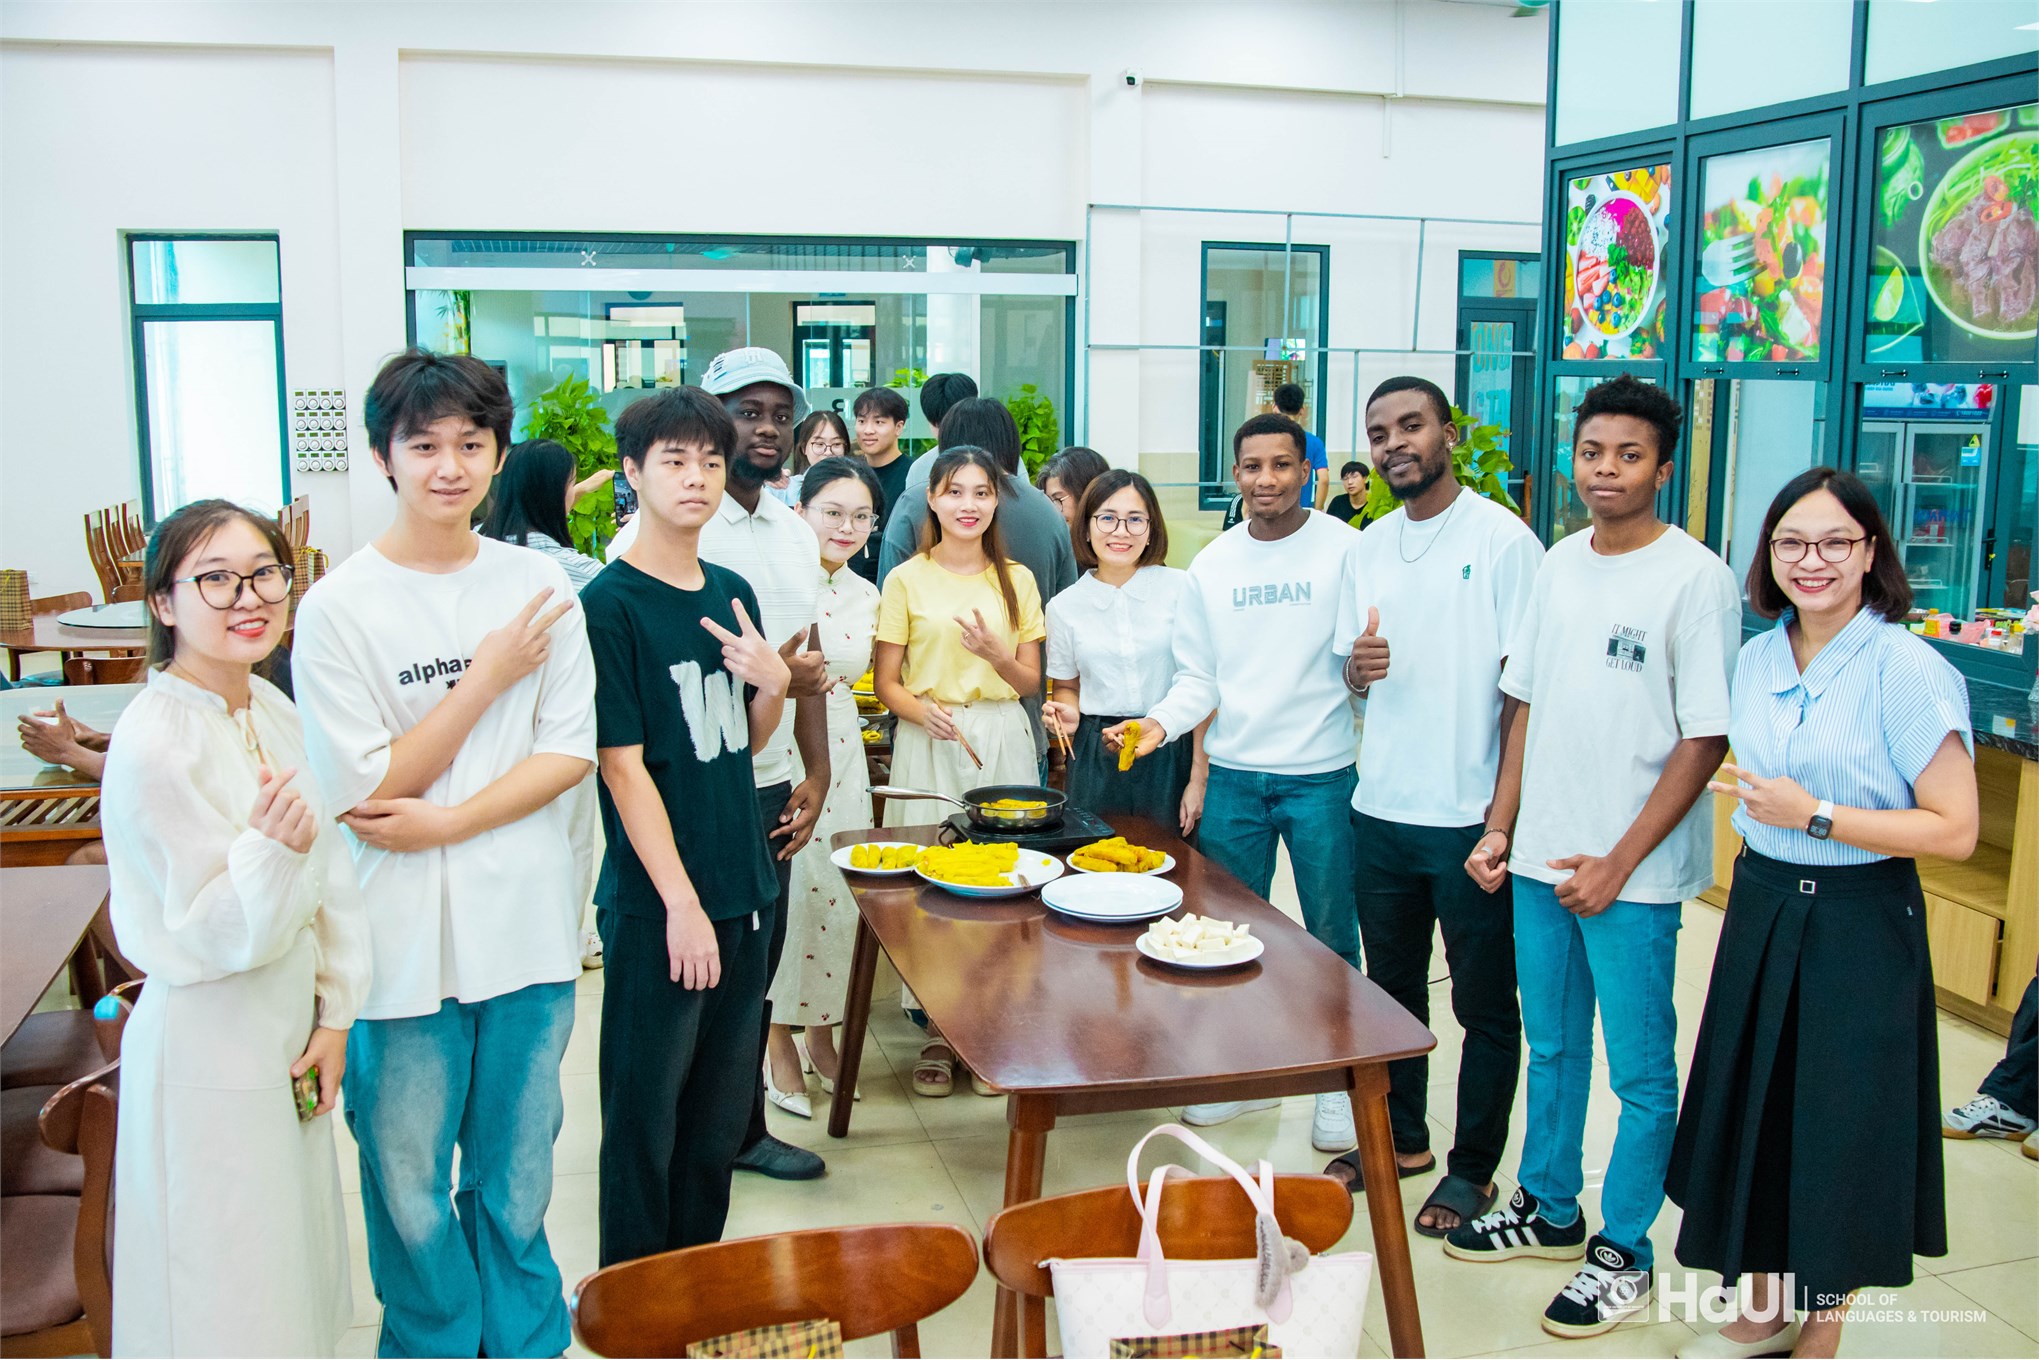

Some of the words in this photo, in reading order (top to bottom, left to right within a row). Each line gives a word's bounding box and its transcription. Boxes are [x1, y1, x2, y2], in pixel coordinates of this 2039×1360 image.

[1233, 581, 1311, 607] URBAN
[1611, 623, 1621, 635] IT
[1621, 626, 1648, 641] MIGHT
[1605, 657, 1620, 669] GET
[1620, 660, 1643, 673] LOUD
